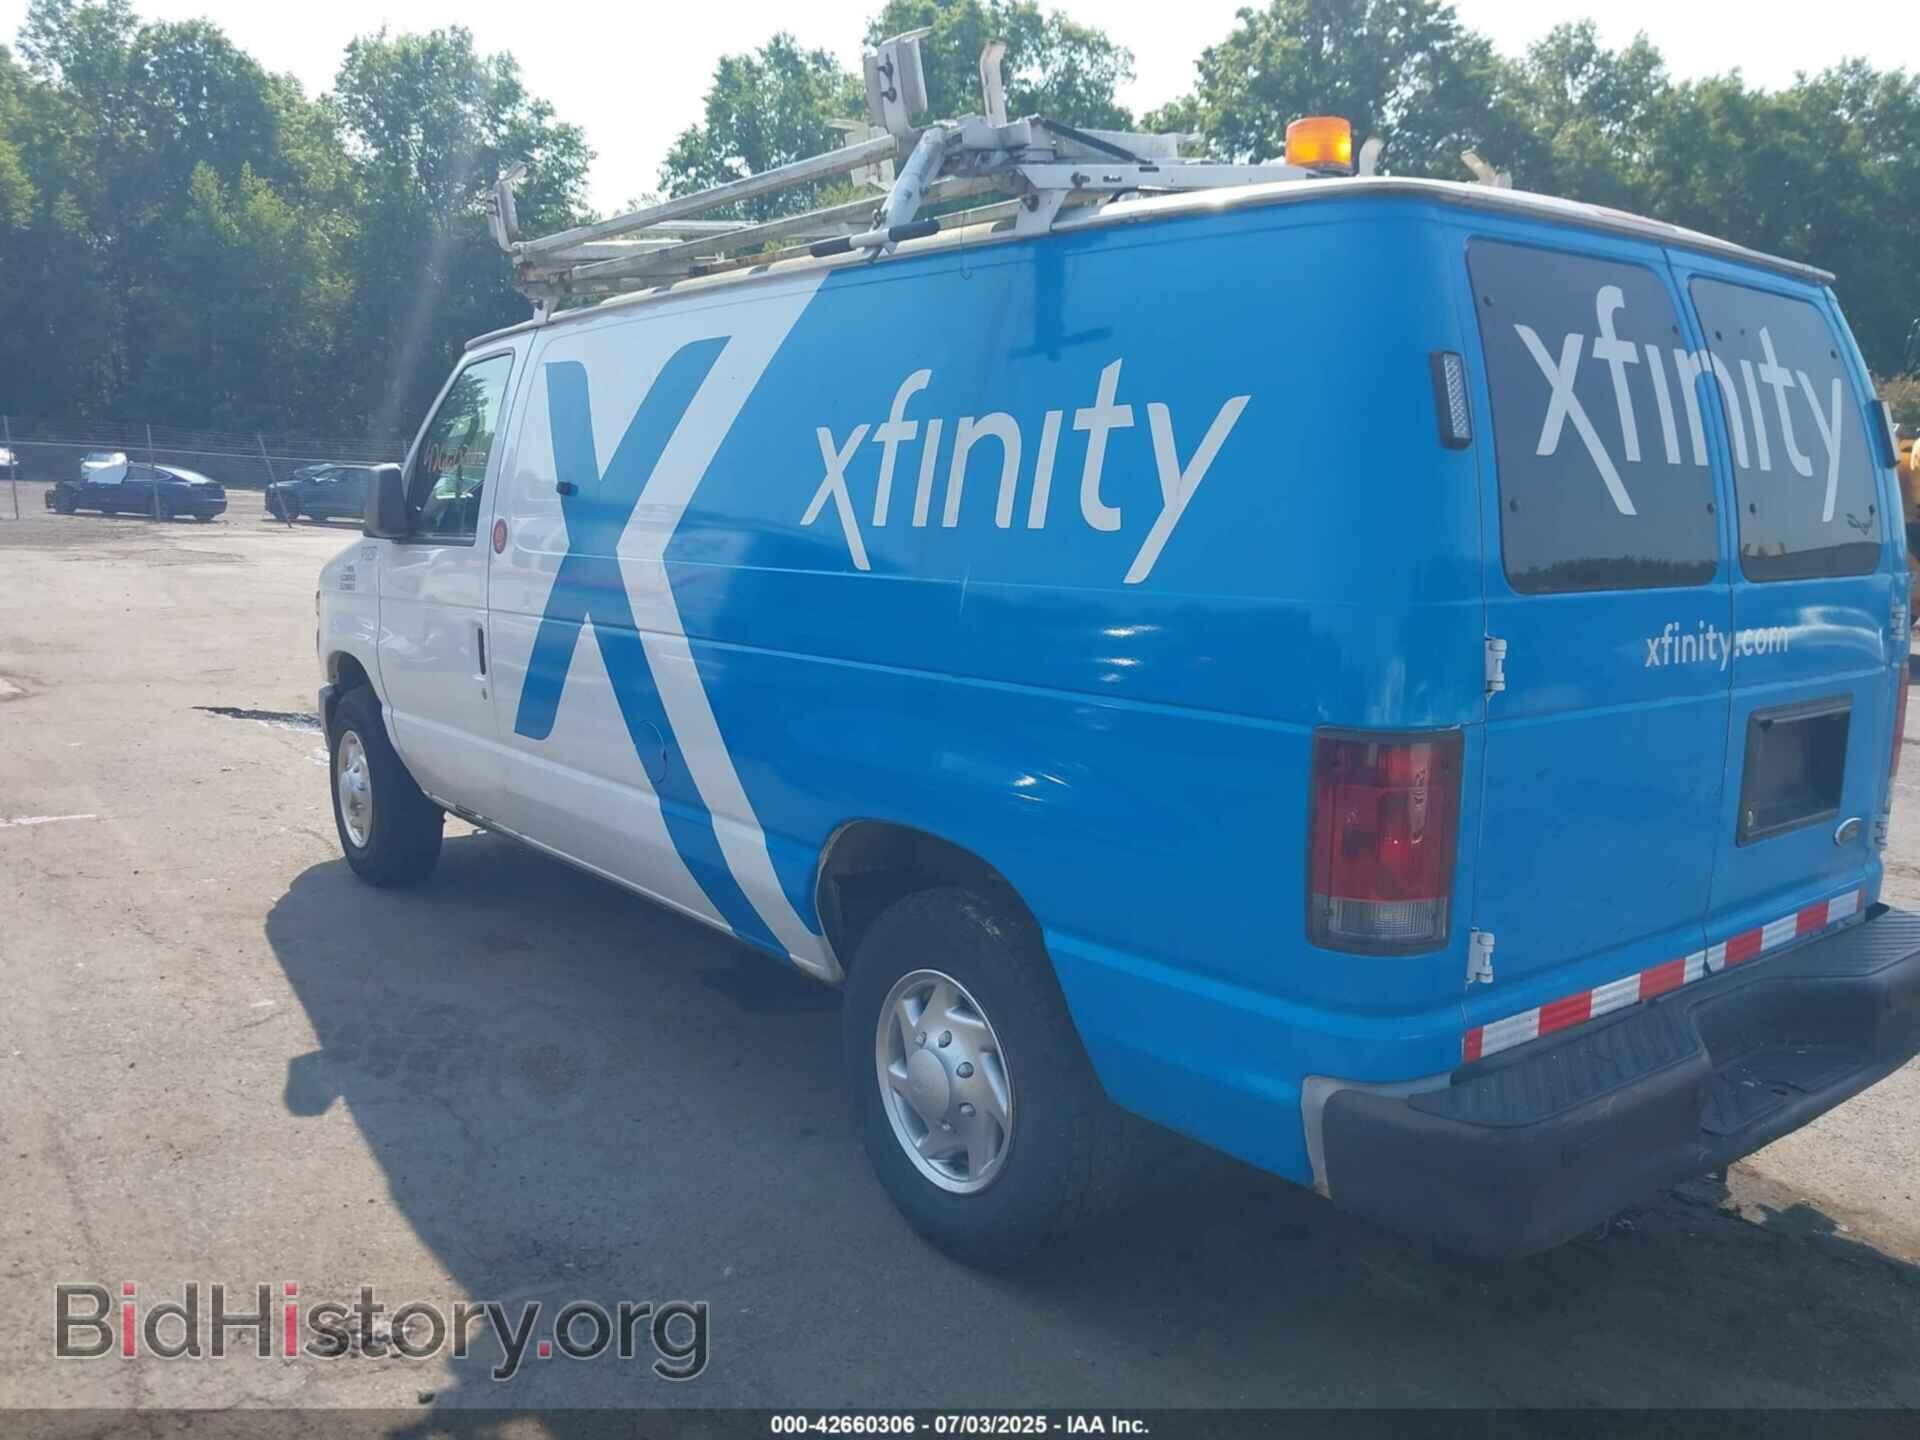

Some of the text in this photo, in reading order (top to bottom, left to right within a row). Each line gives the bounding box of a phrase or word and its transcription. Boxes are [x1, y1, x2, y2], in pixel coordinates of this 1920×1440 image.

[800, 357, 1252, 585] xfinity
[1513, 284, 1842, 523] xfinity
[1644, 620, 1789, 671] xfinity.com
